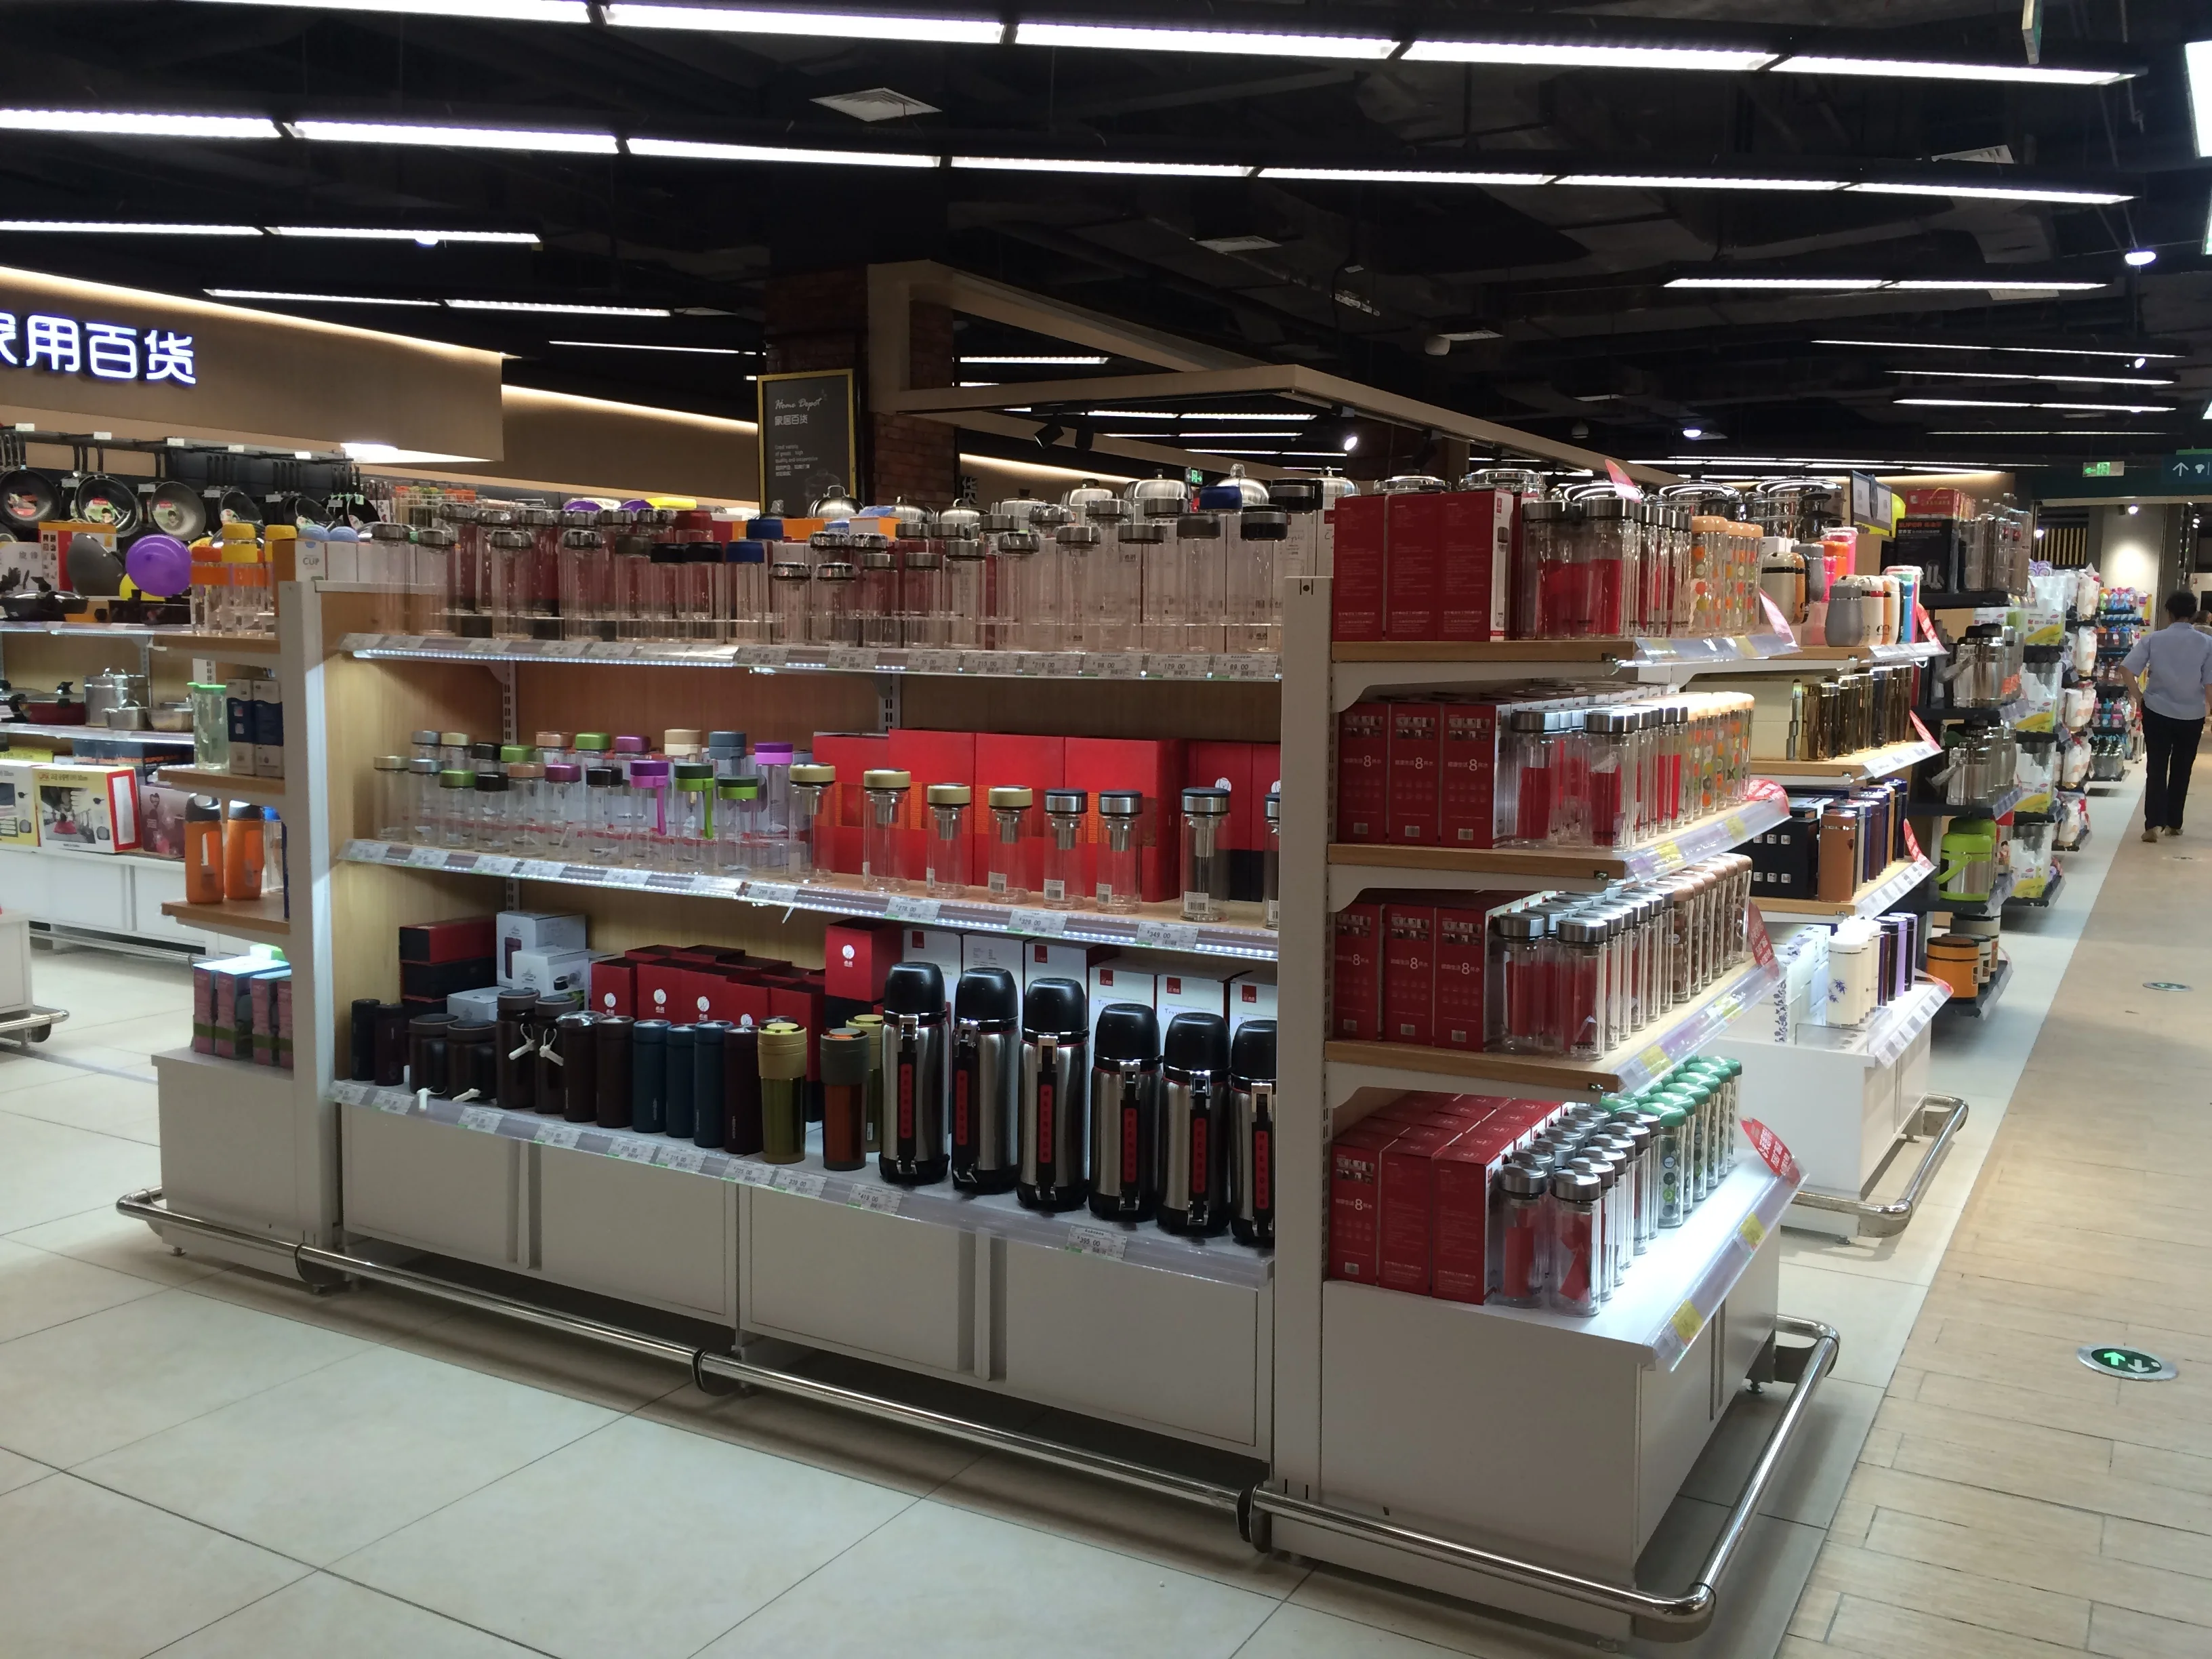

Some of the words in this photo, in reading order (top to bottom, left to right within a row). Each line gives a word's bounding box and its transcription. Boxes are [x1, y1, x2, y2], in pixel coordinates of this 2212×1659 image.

[775, 398, 796, 410] Home
[798, 397, 822, 411] Depot
[775, 414, 808, 426] 家居百货
[302, 557, 320, 566] CUP
